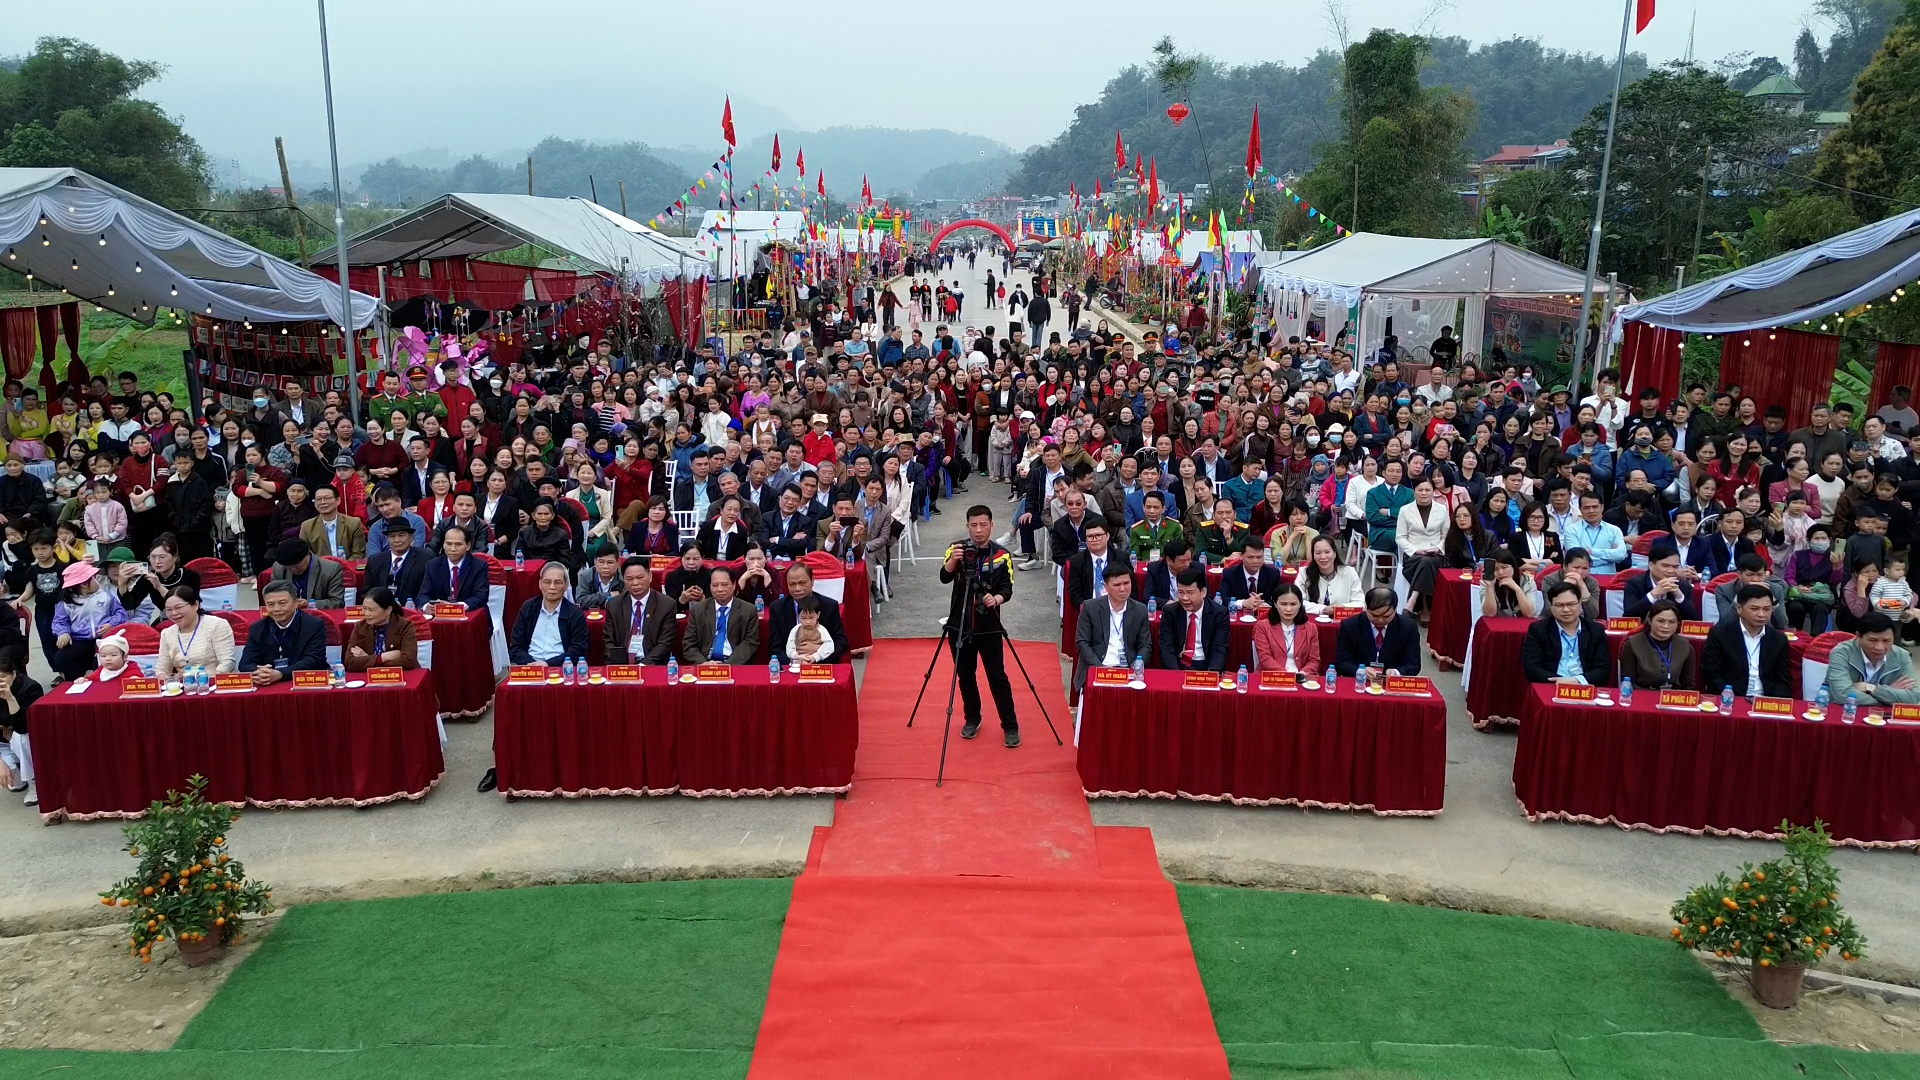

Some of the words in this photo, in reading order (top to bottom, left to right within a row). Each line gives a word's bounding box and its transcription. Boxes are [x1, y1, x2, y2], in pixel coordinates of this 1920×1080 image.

[1610, 619, 1617, 627] XÃ
[1560, 687, 1570, 697] XÃ
[1570, 688, 1580, 698] BA
[1662, 693, 1670, 703] XÃ
[1670, 694, 1686, 704] PHÚC
[1686, 695, 1697, 706] LỘC
[1755, 699, 1762, 710] XÃ
